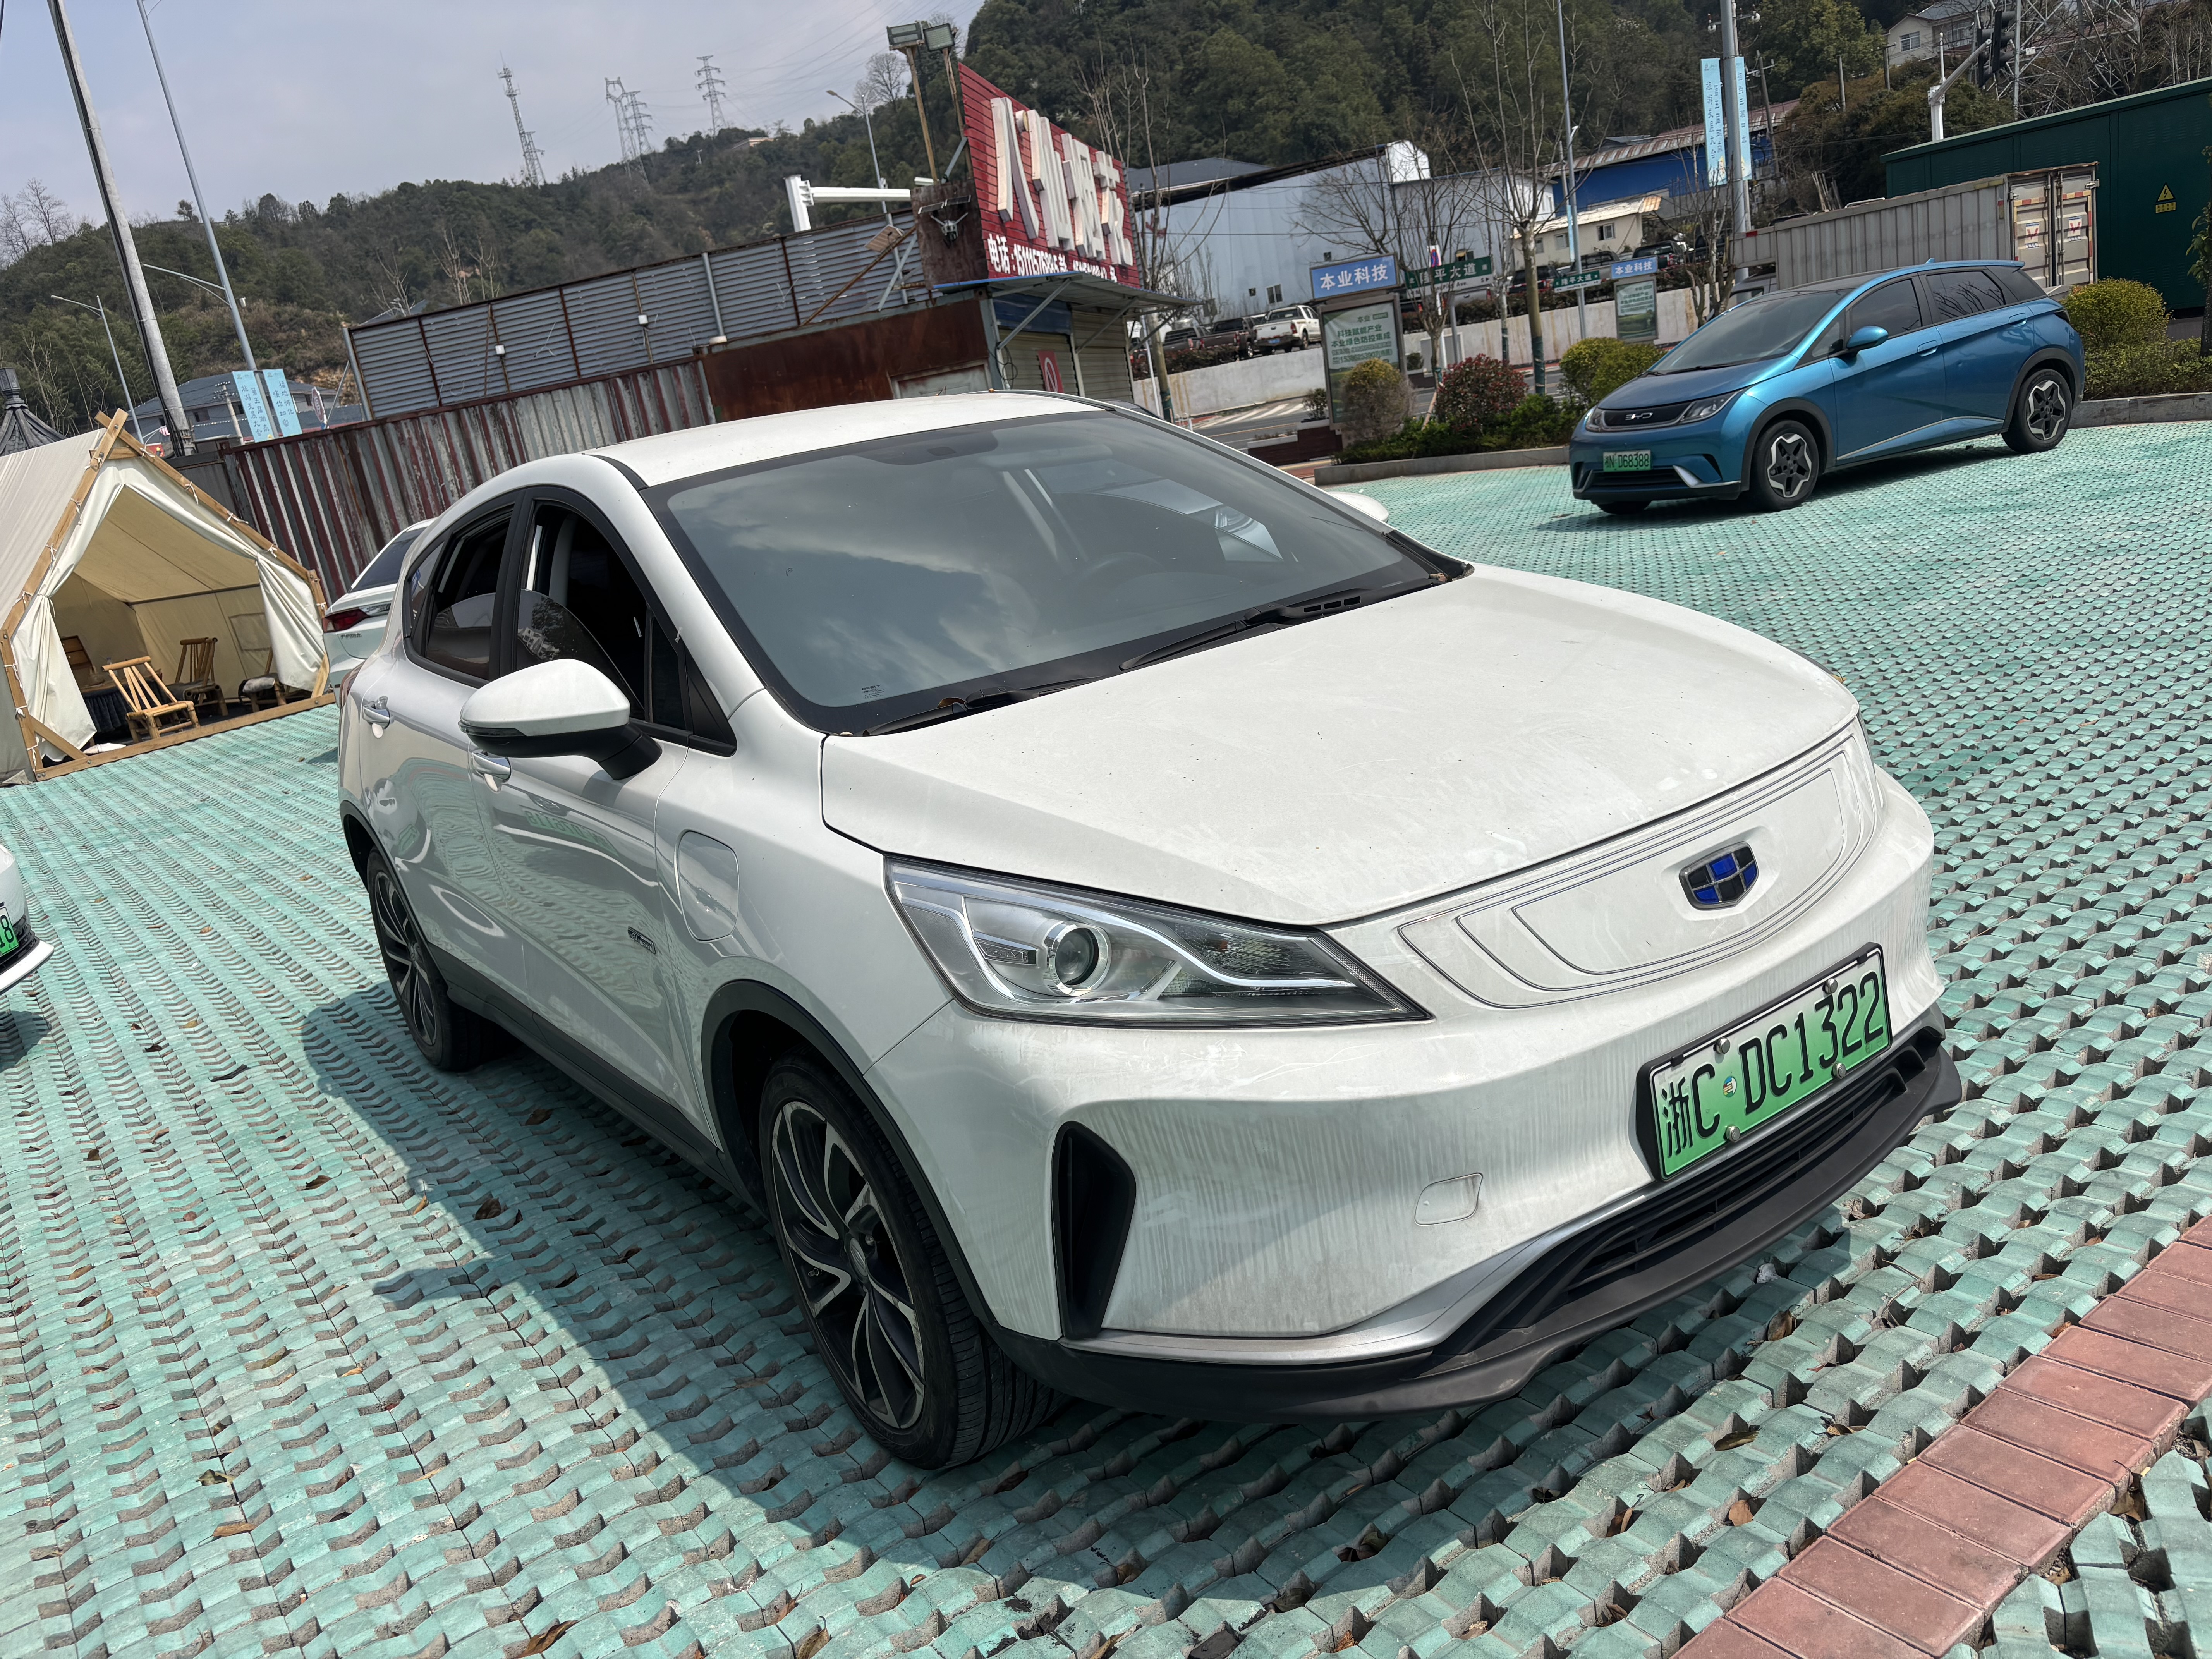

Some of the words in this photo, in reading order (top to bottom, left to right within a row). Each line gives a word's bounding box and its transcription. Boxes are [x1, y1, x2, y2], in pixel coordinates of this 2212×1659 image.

[1615, 261, 1653, 275] 本业科技
[1320, 264, 1389, 290] 本业科技
[1625, 412, 1653, 421] BYD
